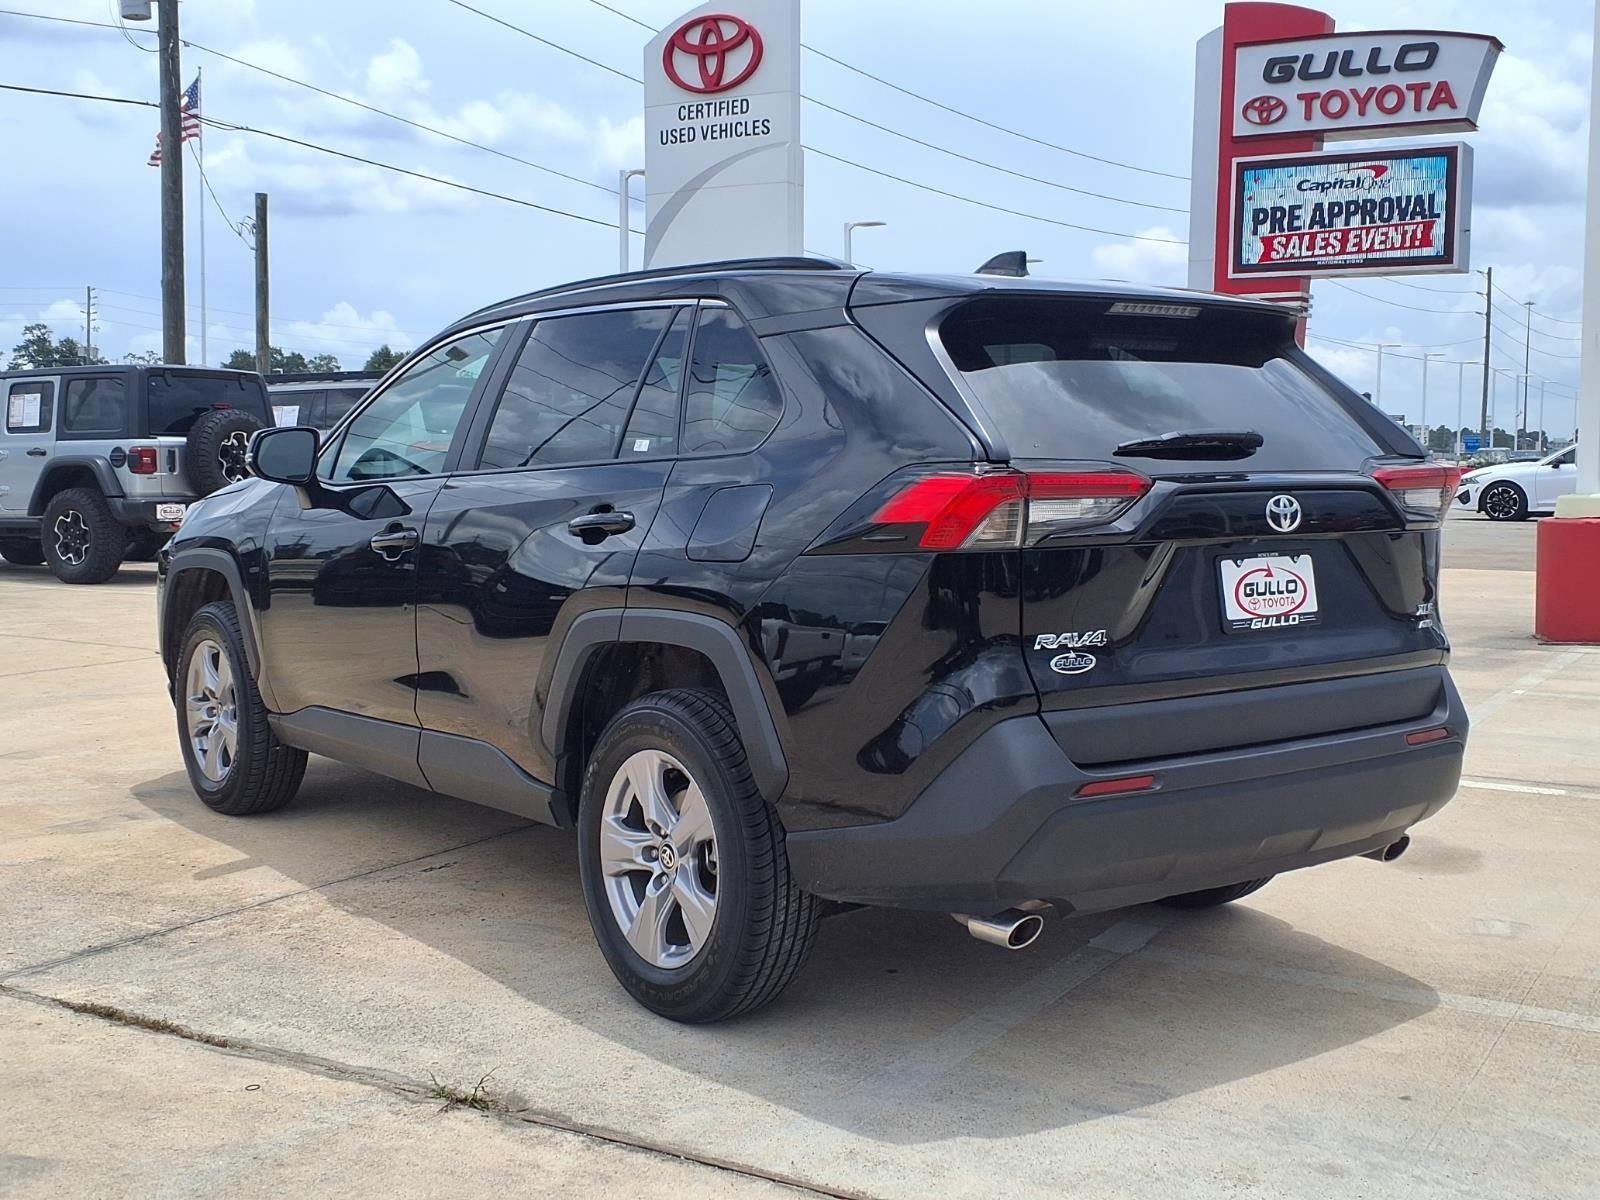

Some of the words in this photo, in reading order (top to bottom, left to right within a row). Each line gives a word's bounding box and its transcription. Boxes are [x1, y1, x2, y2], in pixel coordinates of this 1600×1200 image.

[1262, 42, 1440, 84] GULLO
[678, 98, 750, 121] CERTIFIED
[1297, 81, 1458, 121] TOYOTA
[660, 126, 696, 146] USED
[700, 119, 771, 141] VEHICLES
[1252, 204, 1304, 236] PRE
[1308, 194, 1441, 230] APPROVAL
[1270, 233, 1342, 260] SALES
[1346, 224, 1424, 253] EVENT!
[1243, 579, 1298, 598] GULLO
[1262, 596, 1297, 609] TOYOTA
[1250, 614, 1300, 629] GULLO
[1033, 629, 1108, 650] RAV4
[1054, 657, 1093, 668] GULLO
